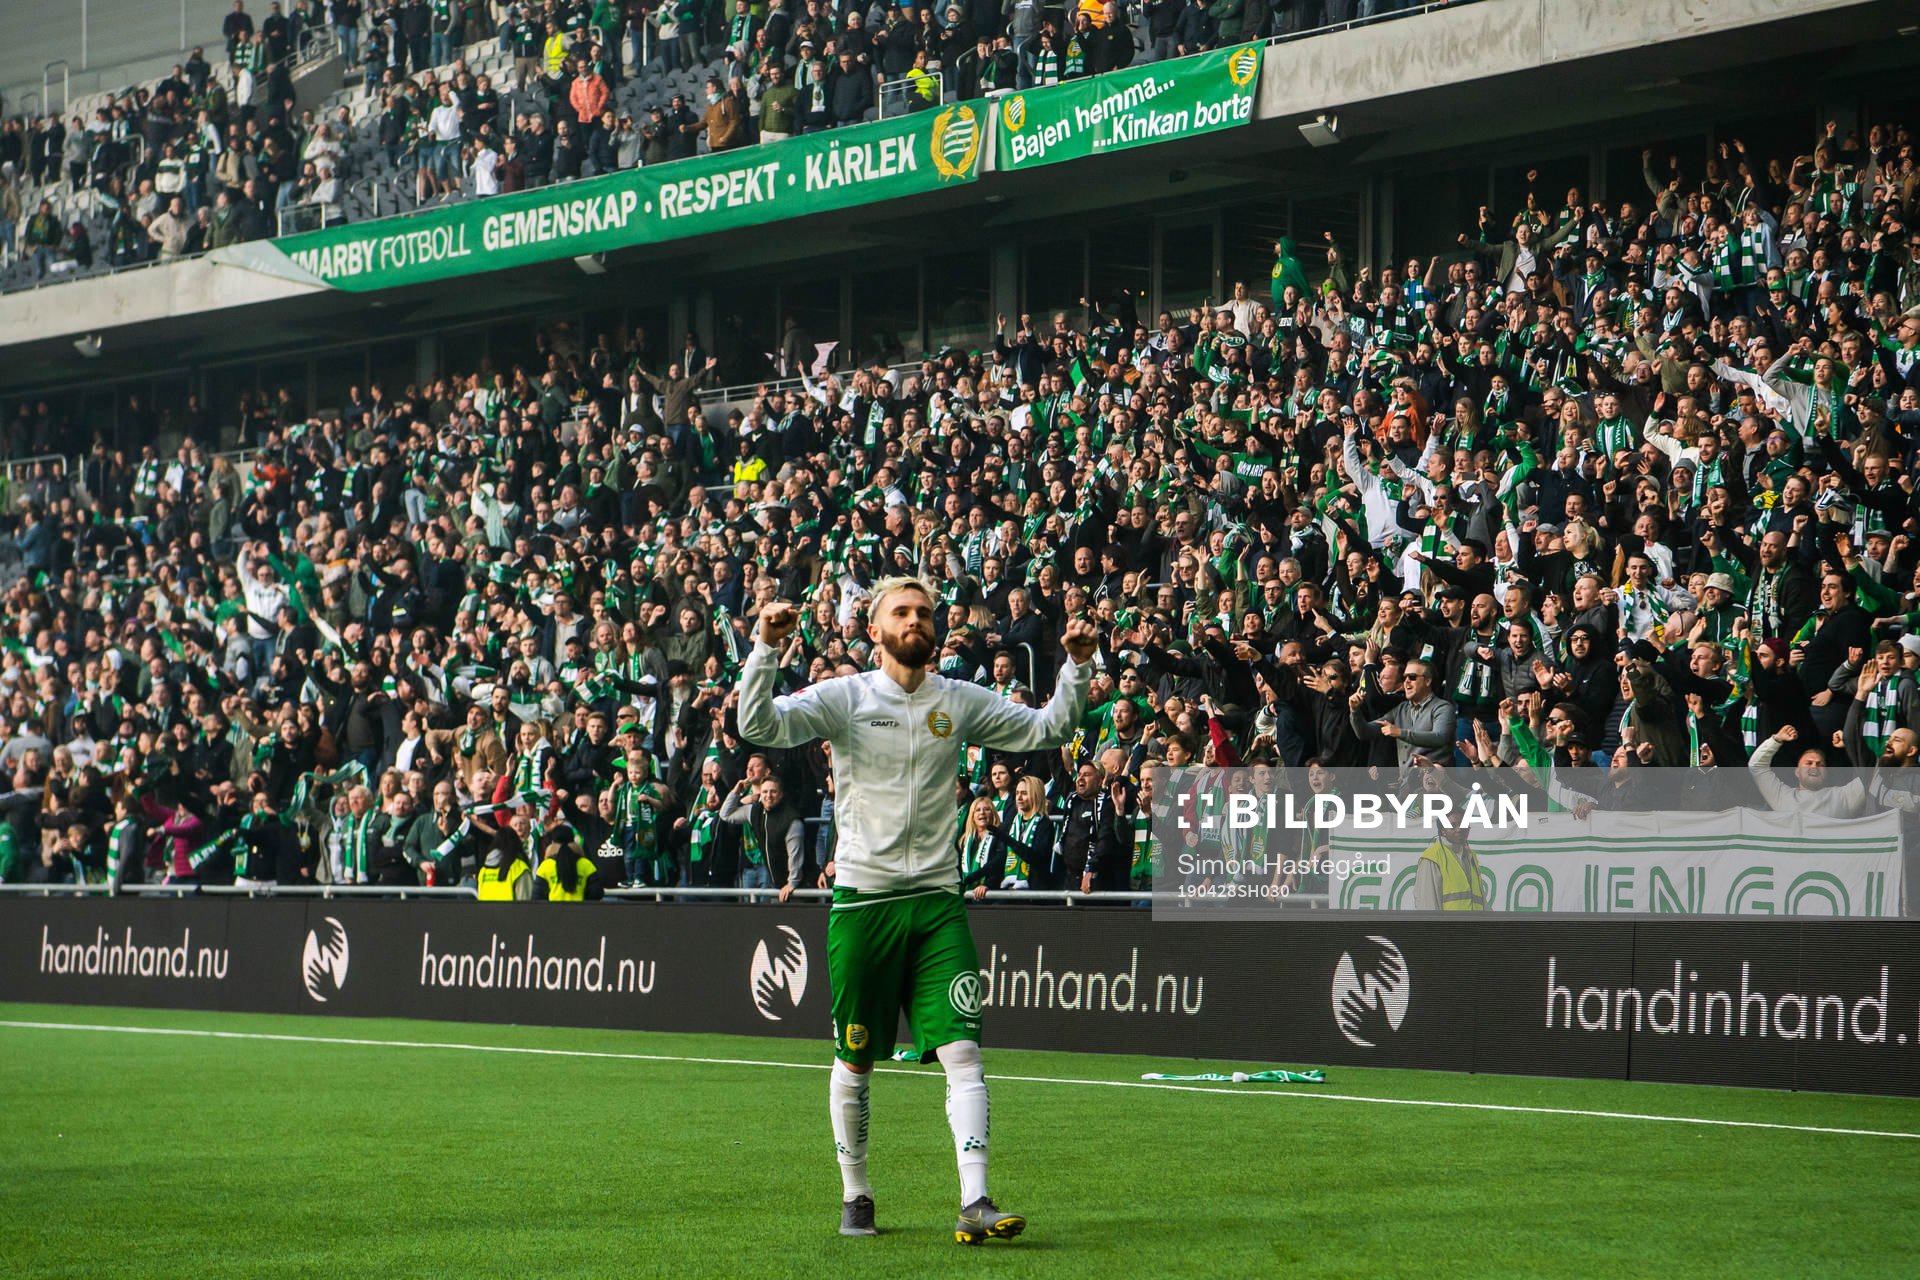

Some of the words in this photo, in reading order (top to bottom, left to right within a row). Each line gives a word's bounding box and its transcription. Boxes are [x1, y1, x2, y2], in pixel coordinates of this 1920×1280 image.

[1011, 118, 1071, 164] Bajen
[1074, 77, 1175, 132] hemma...
[1093, 110, 1189, 149] ...Kinkan
[1194, 96, 1253, 129] borta
[380, 223, 472, 269] FOTBOLL
[483, 190, 637, 251] GEMENSKAP
[659, 161, 780, 219] RESPEKT
[806, 133, 918, 192] KÄRLEK
[870, 720, 894, 728] CRAFT
[598, 847, 623, 857] adida
[41, 924, 229, 979] handinhand.nu
[421, 932, 656, 994] handinhand.nu
[979, 944, 1205, 1014] dinhand.nu
[1546, 956, 1920, 1045] handinhand.
